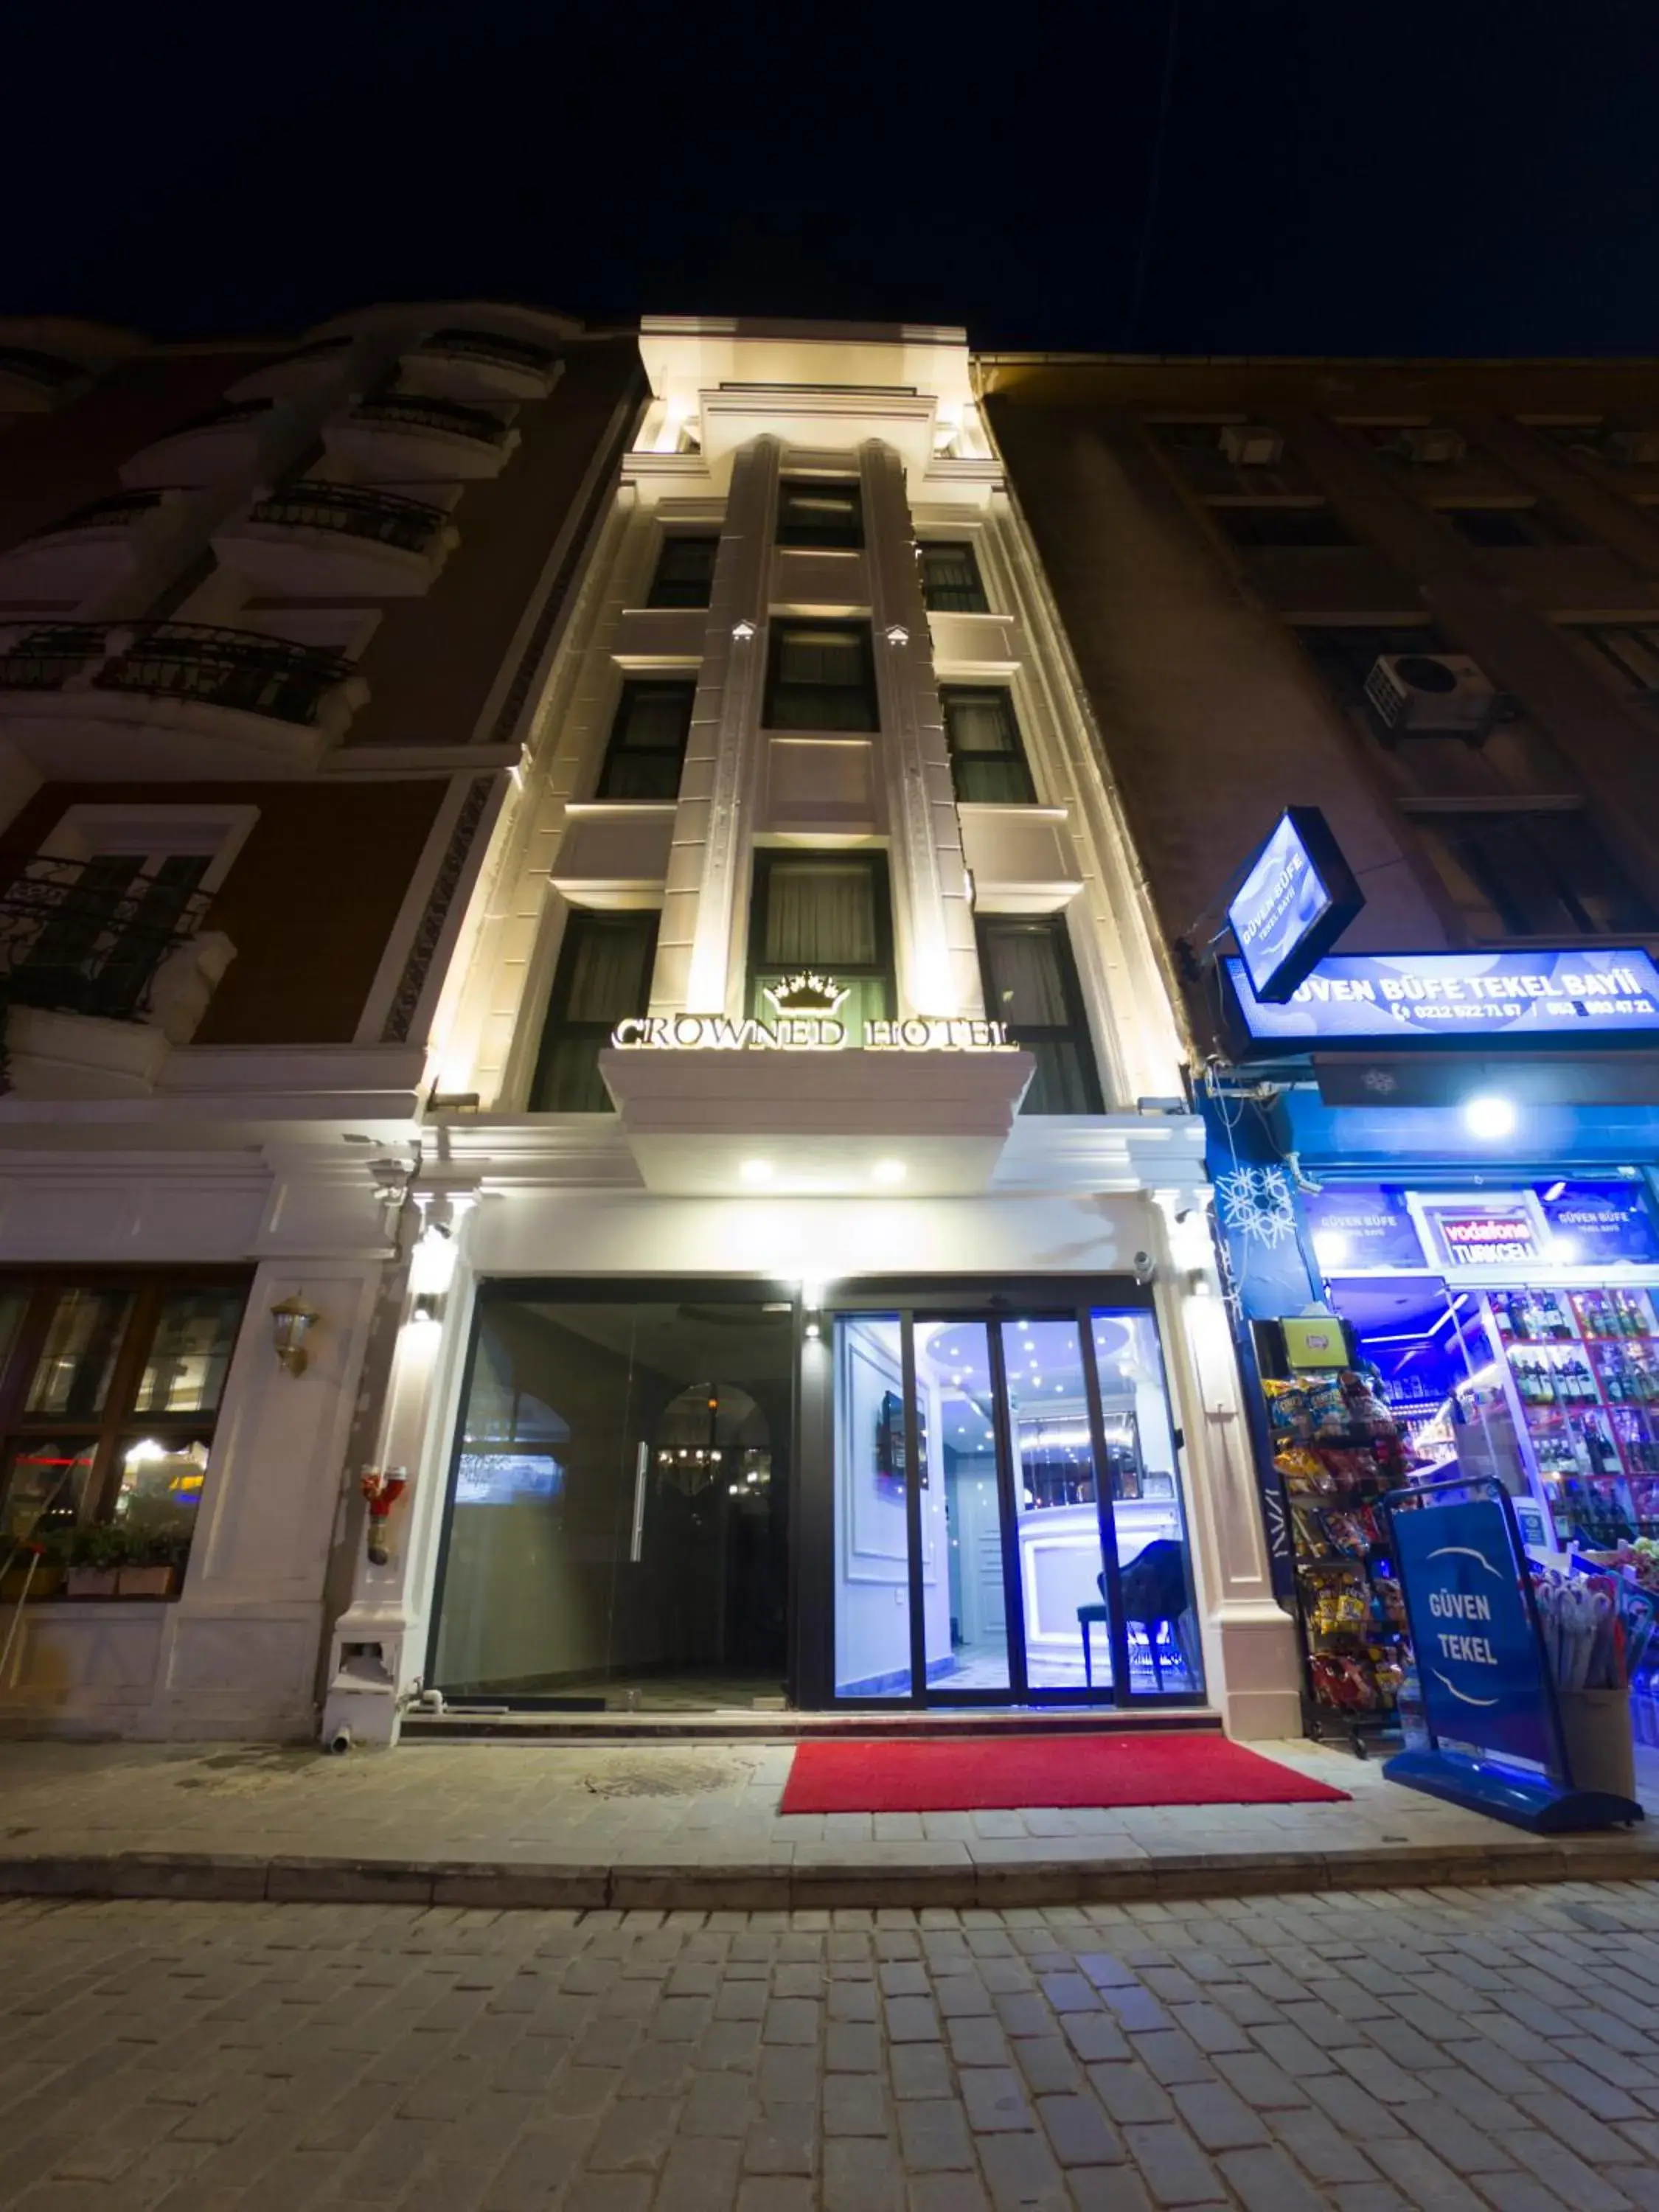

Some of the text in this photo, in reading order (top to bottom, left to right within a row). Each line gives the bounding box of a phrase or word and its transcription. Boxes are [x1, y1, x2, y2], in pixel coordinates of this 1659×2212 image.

[1380, 974, 1465, 1001] BÜFE
[1464, 975, 1563, 998] TEKEL
[611, 1017, 1020, 1052] CROWNED HOTEL
[1445, 1220, 1531, 1241] vodafone
[1429, 1587, 1491, 1621] GÜVEN
[1437, 1632, 1498, 1665] TEKEL
